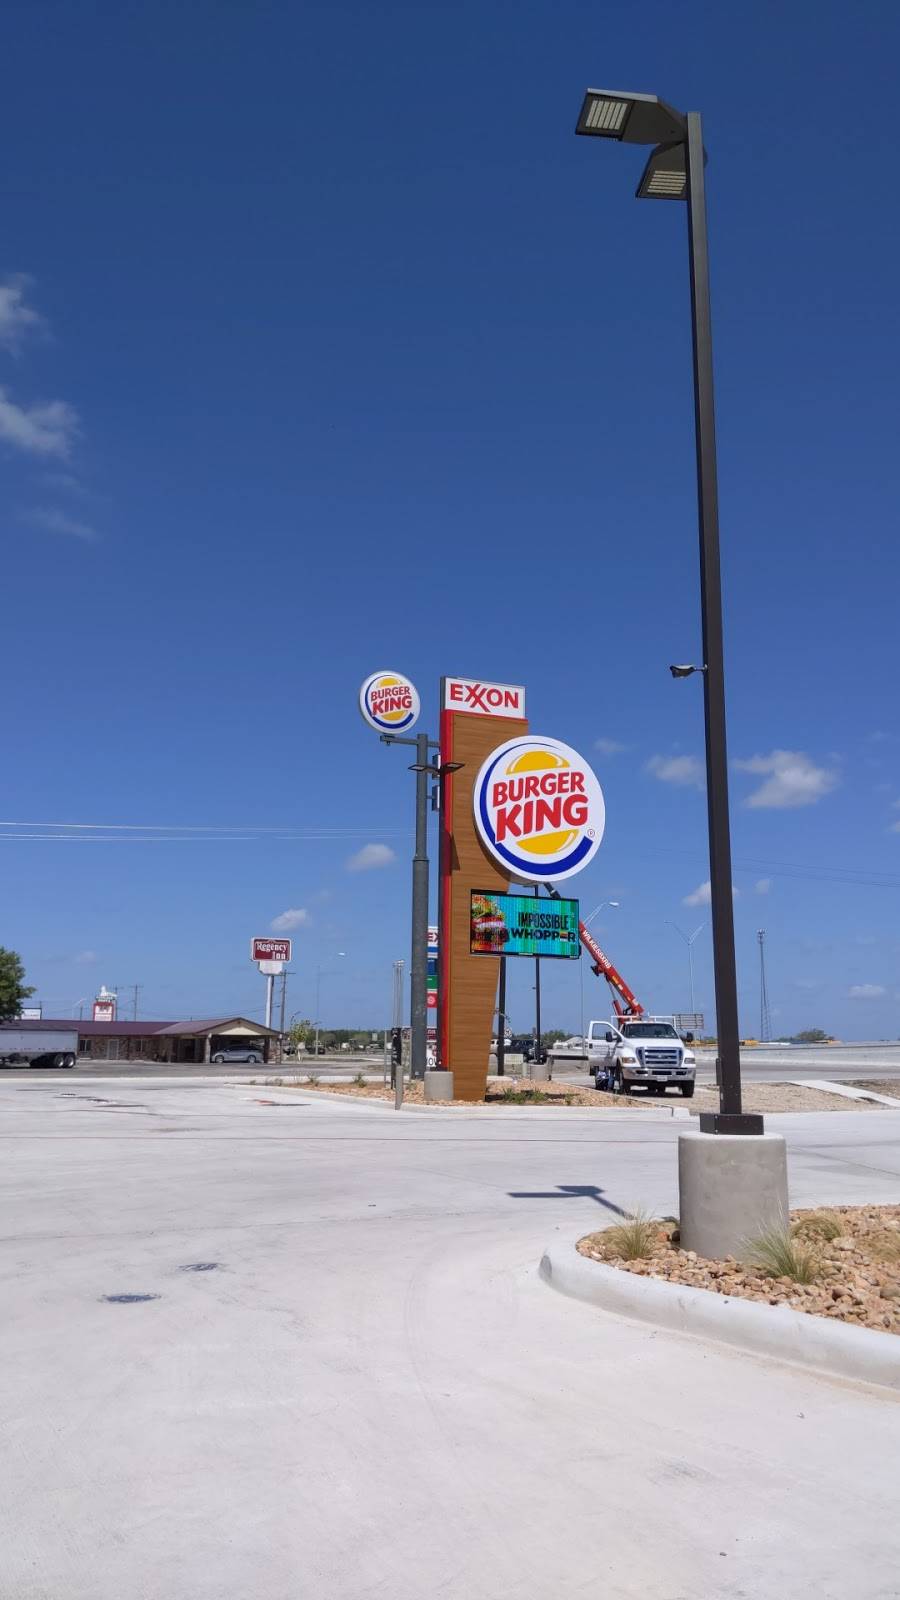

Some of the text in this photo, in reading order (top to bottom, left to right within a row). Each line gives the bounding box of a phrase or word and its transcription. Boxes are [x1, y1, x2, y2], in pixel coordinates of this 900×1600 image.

[371, 686, 410, 702] BURGER
[450, 684, 519, 712] EXXON
[372, 695, 413, 715] KING
[493, 772, 585, 807] BURGER
[496, 794, 589, 841] KING
[518, 912, 569, 930] IMPOSSIBLE
[511, 928, 576, 943] WHOPPER
[256, 941, 287, 953] Regency
[272, 951, 286, 961] Inn
